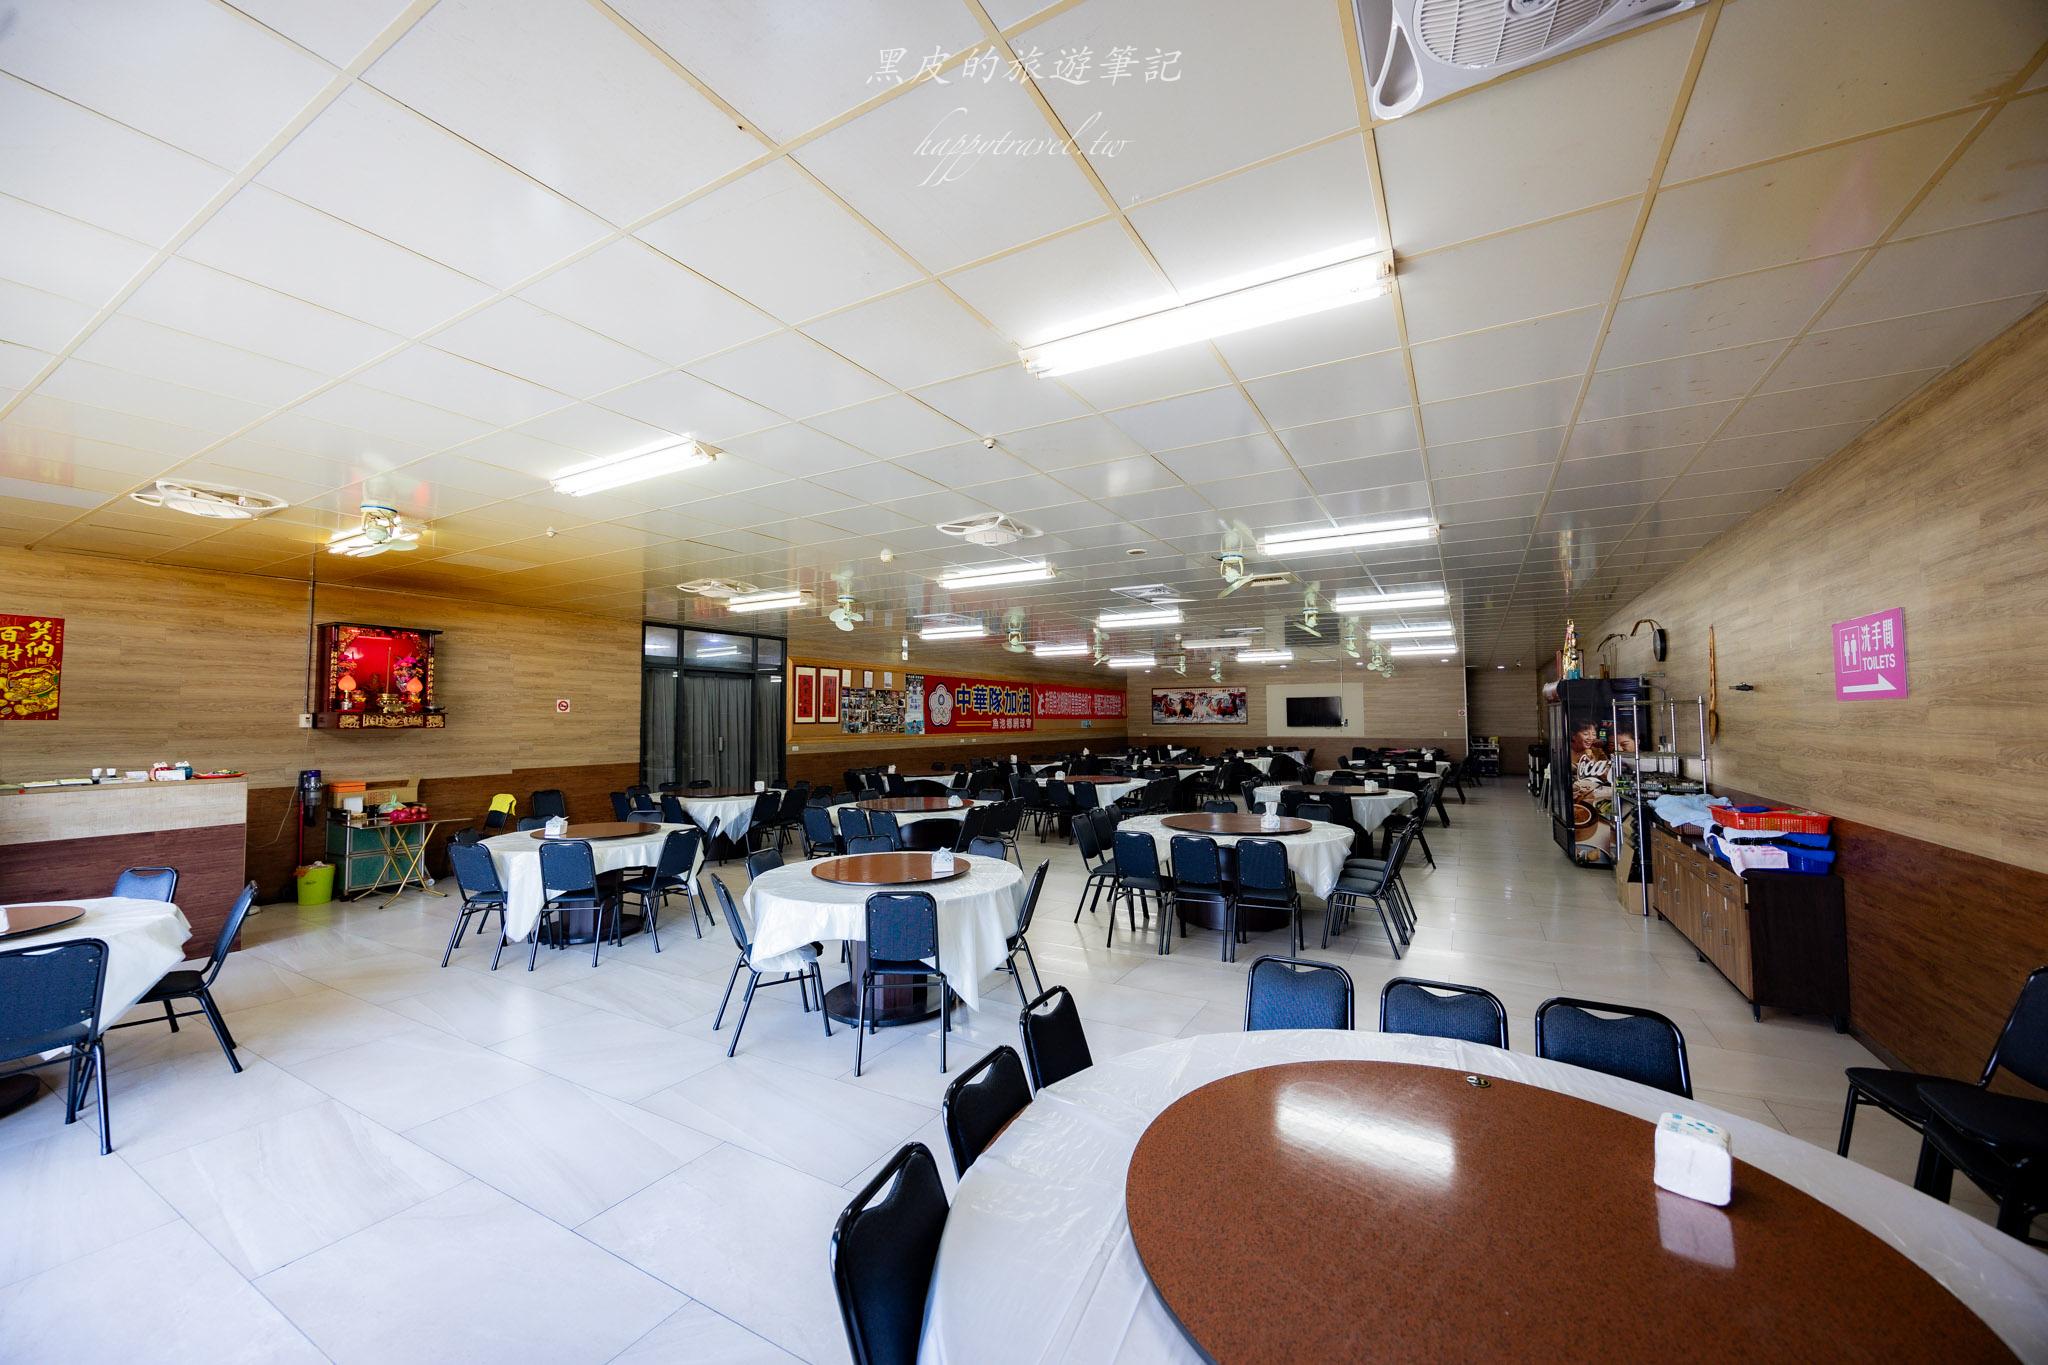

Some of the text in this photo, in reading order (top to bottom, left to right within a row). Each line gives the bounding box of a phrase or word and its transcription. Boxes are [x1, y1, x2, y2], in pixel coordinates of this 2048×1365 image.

[1860, 618, 1895, 652] 洗手間
[1862, 653, 1896, 671] TOILETS
[955, 683, 1032, 716] 中華隊加油
